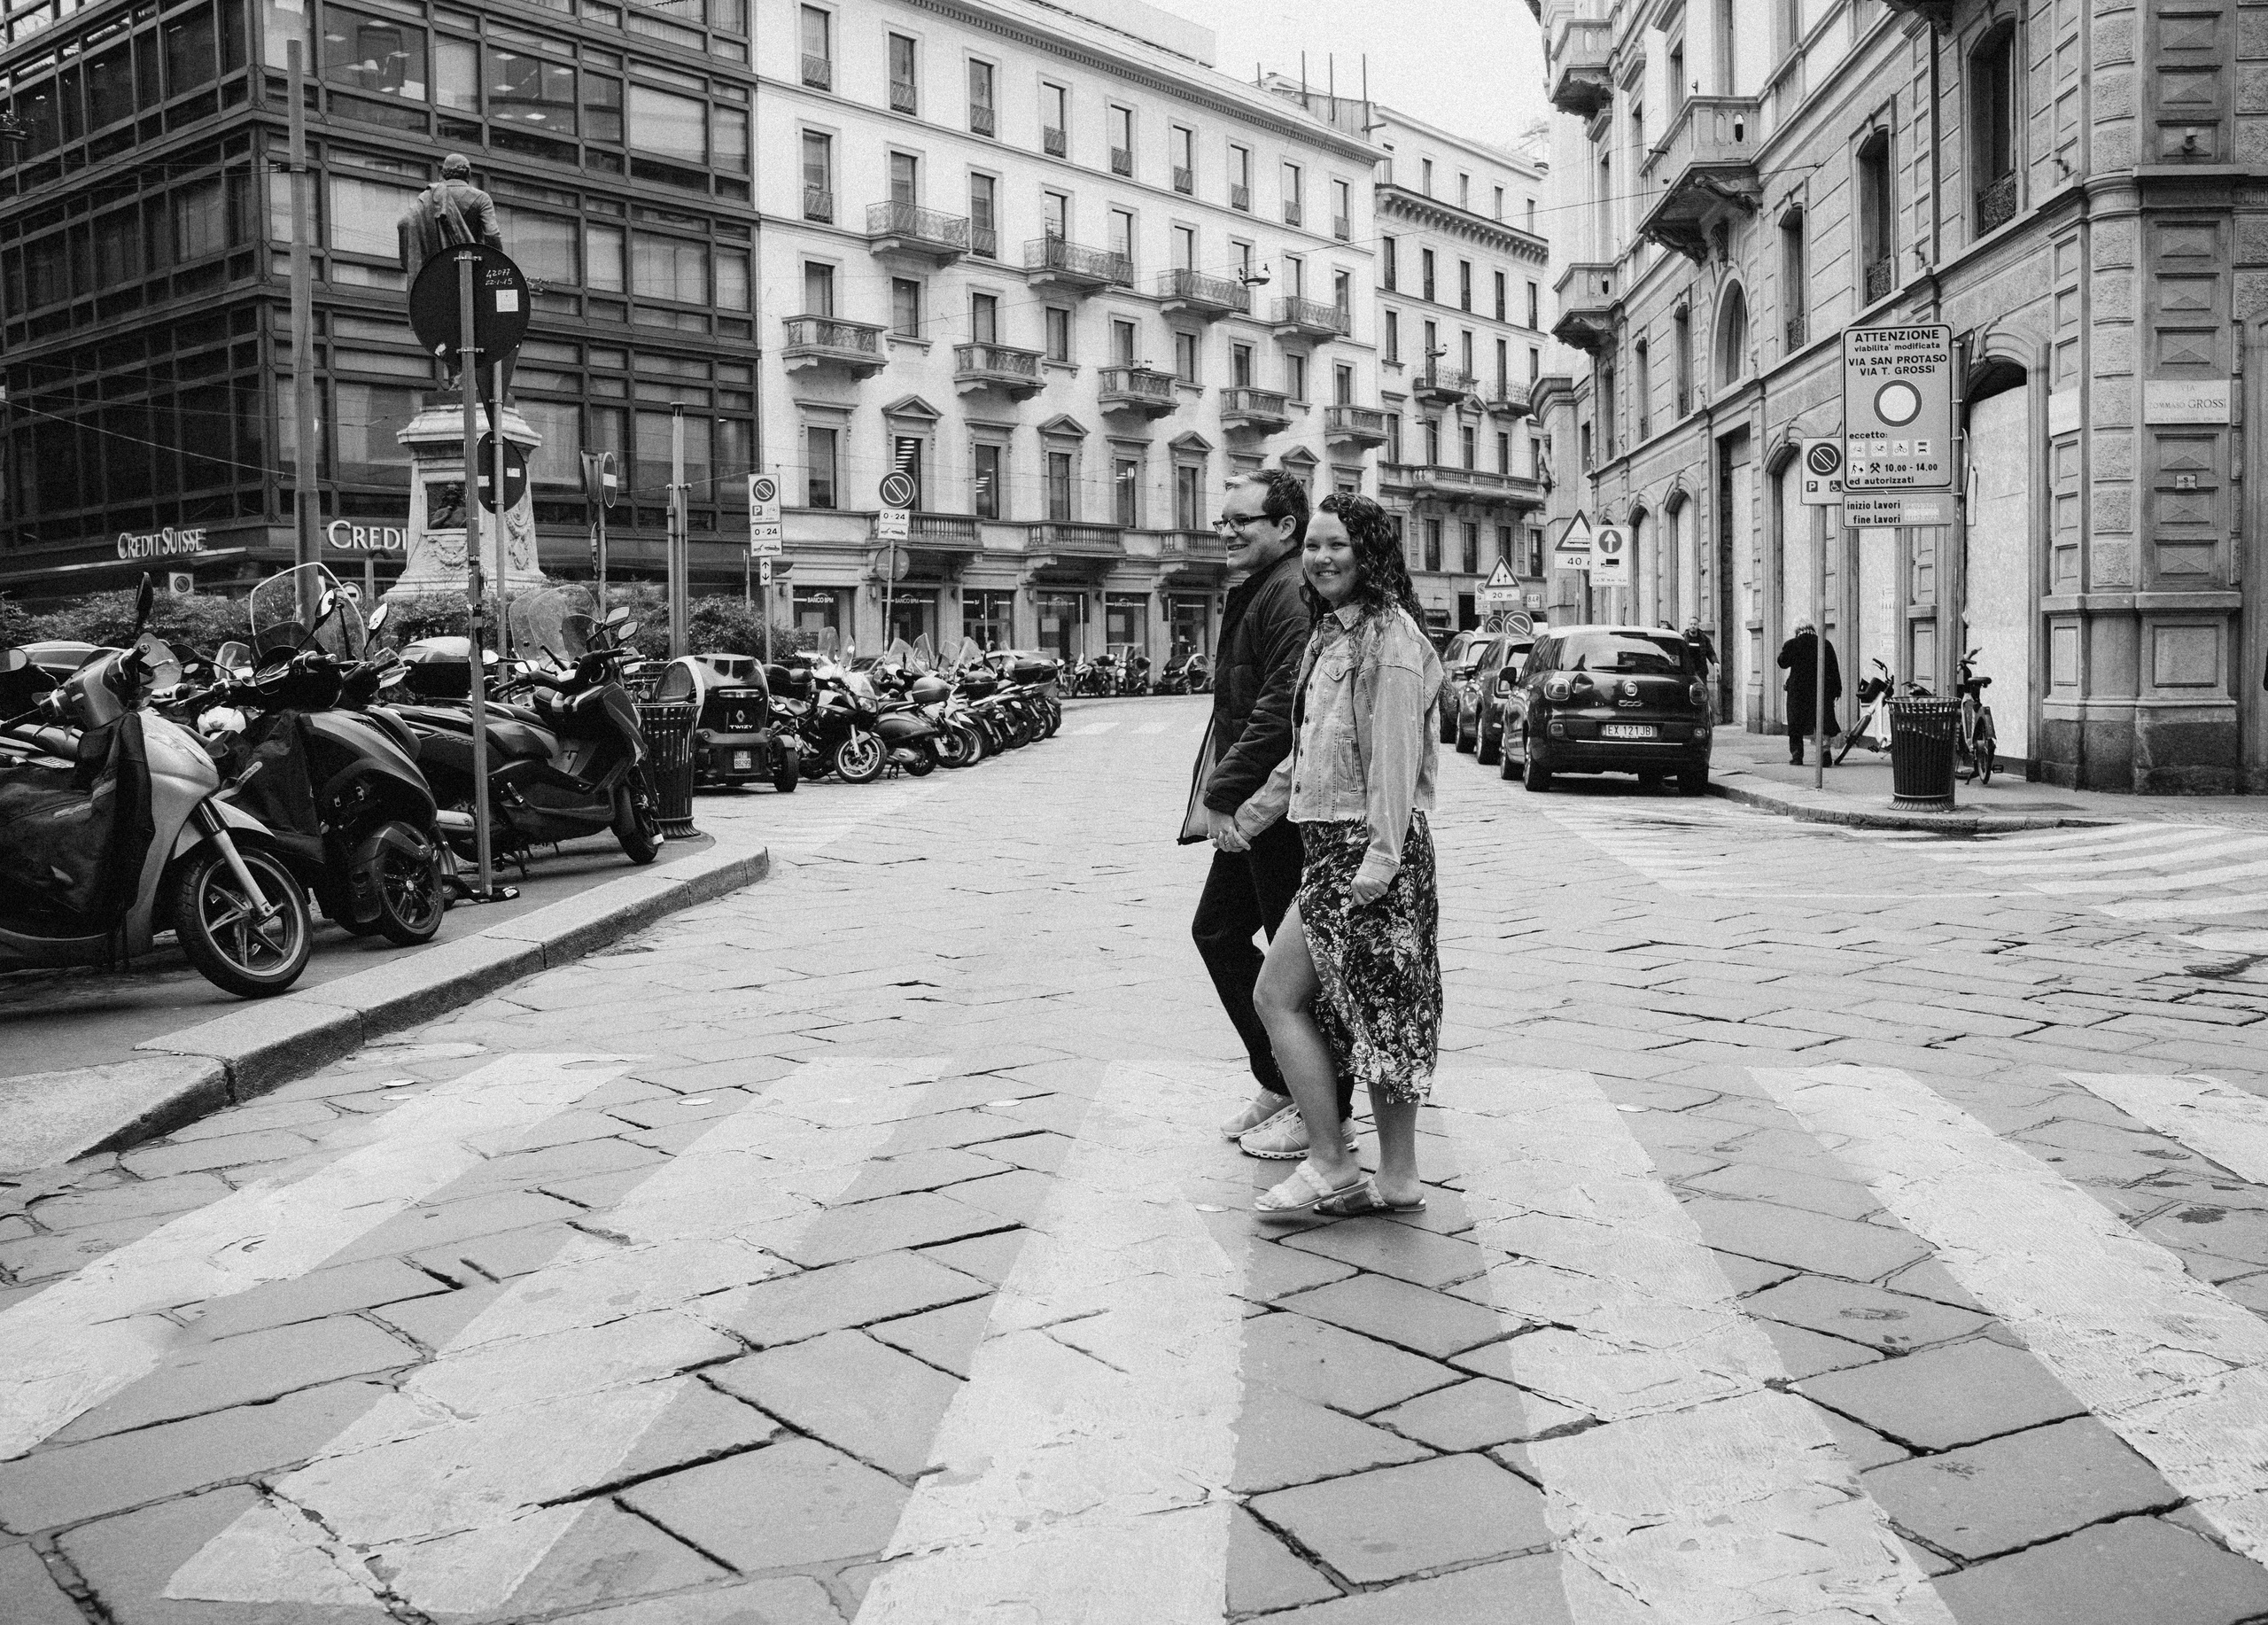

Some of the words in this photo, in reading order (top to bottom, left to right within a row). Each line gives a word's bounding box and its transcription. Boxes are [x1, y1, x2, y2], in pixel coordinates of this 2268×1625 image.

[1854, 329, 1939, 342] ATTENZIONE
[1894, 341, 1940, 351] modificata
[1848, 358, 1867, 367] VIA
[1870, 356, 1893, 366] SAN
[1897, 354, 1948, 364] PROTASO
[1860, 368, 1878, 377] VIA
[1881, 367, 1891, 376] T.
[1894, 365, 1936, 375] GROSSI
[2187, 399, 2227, 408] GROSSI
[1849, 431, 1889, 439] eccetto:
[1884, 463, 1907, 472] 10.00
[1915, 463, 1938, 471] 14.00
[1864, 476, 1915, 485] autorizzati
[1808, 482, 1817, 492] P
[1846, 501, 1871, 510] inizio
[1874, 500, 1901, 509] lavori
[753, 506, 762, 516] P
[1853, 515, 1871, 525] fine
[1874, 514, 1901, 524] lavori
[118, 532, 161, 559] CREDIT
[162, 526, 207, 556] SUISSE
